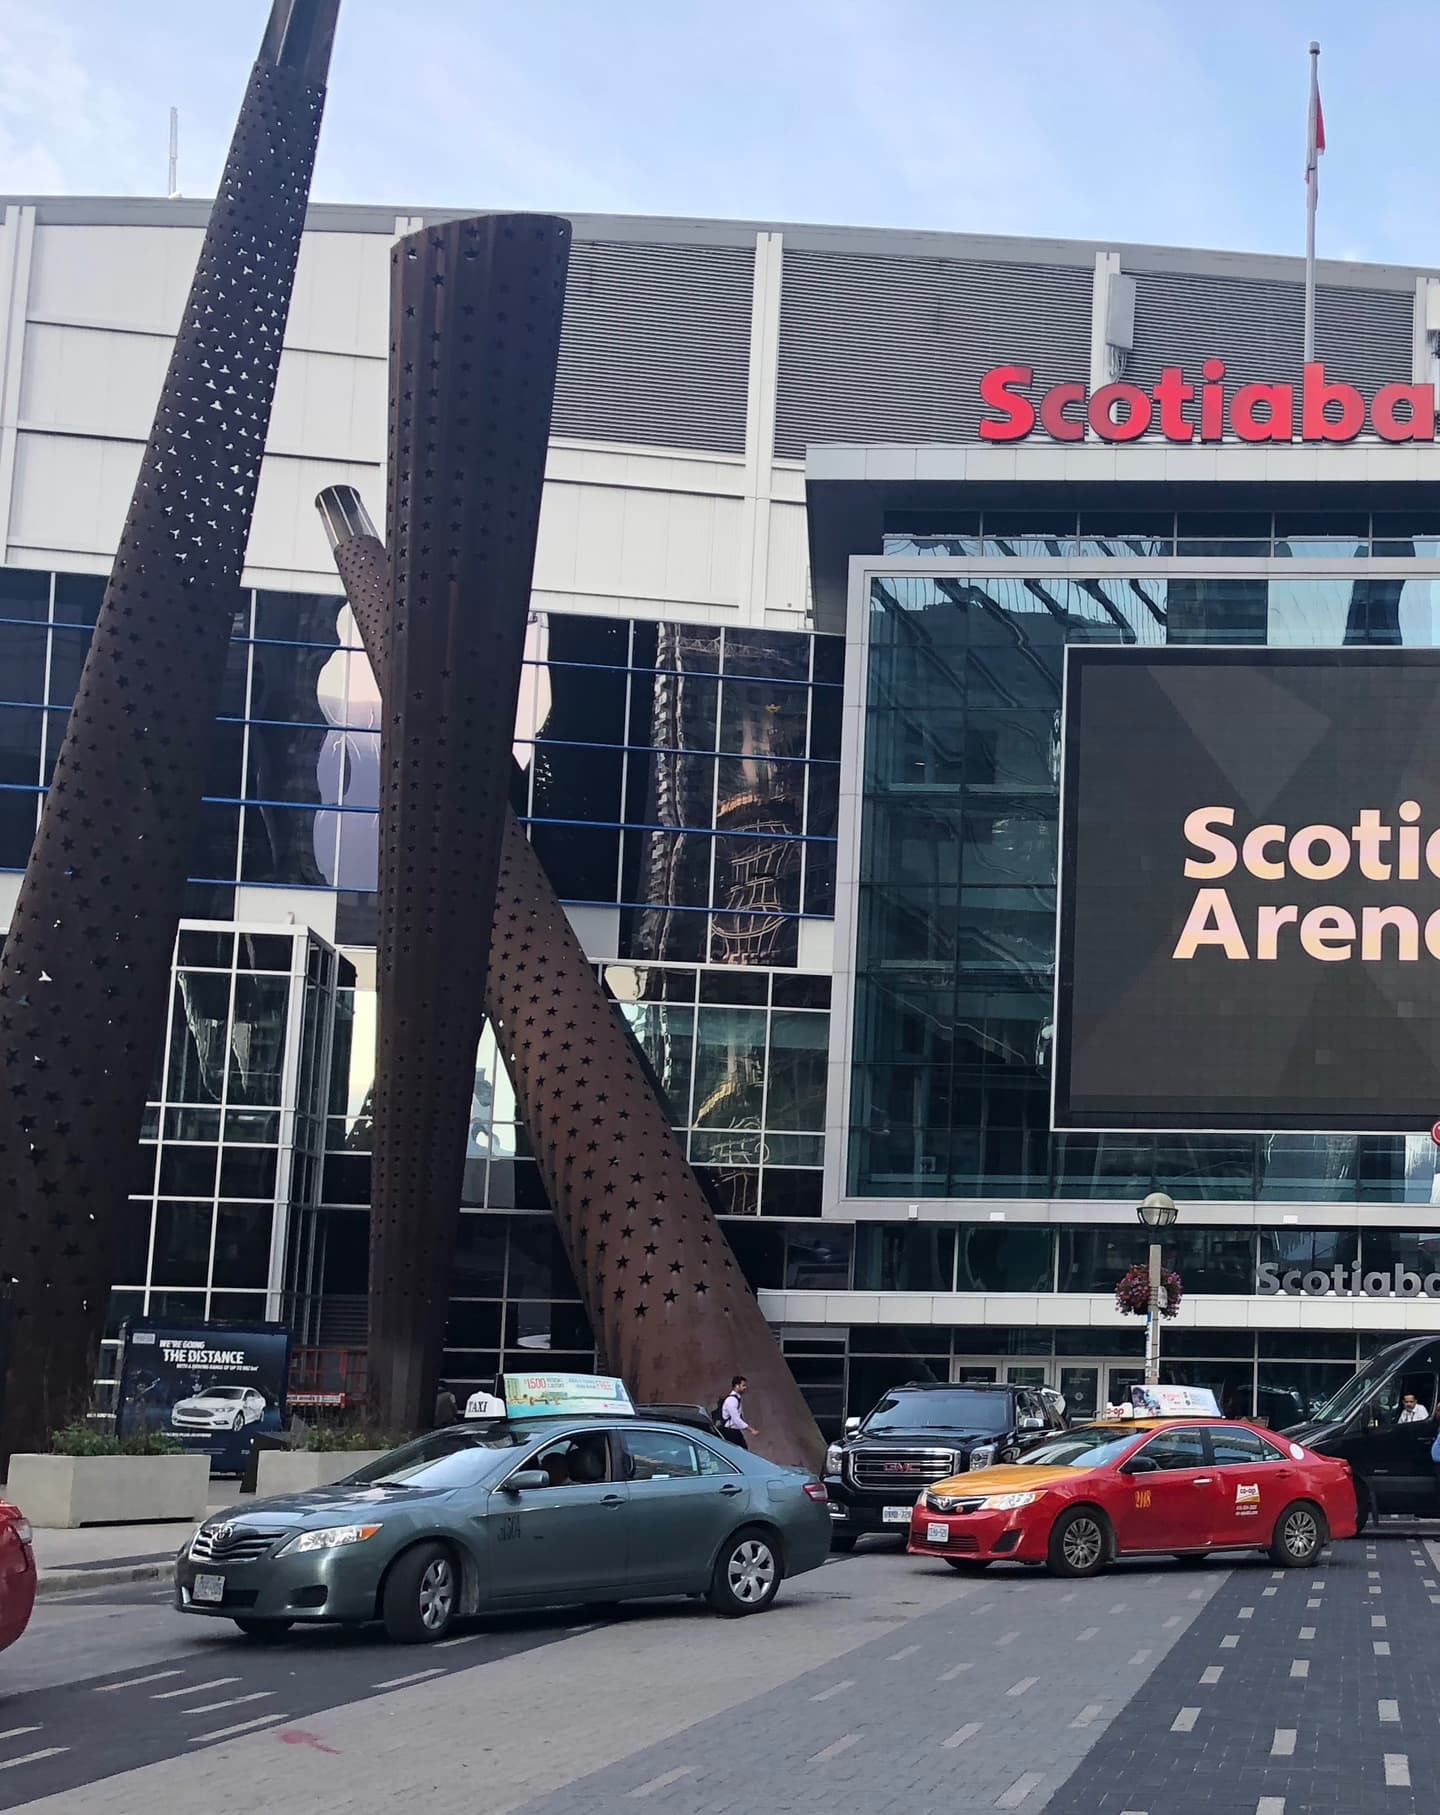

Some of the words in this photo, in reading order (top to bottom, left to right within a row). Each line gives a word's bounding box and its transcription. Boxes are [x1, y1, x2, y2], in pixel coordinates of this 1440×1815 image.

[162, 1348, 187, 1362] THE
[187, 1350, 245, 1364] DISTANCE
[467, 1400, 488, 1413] TAXI
